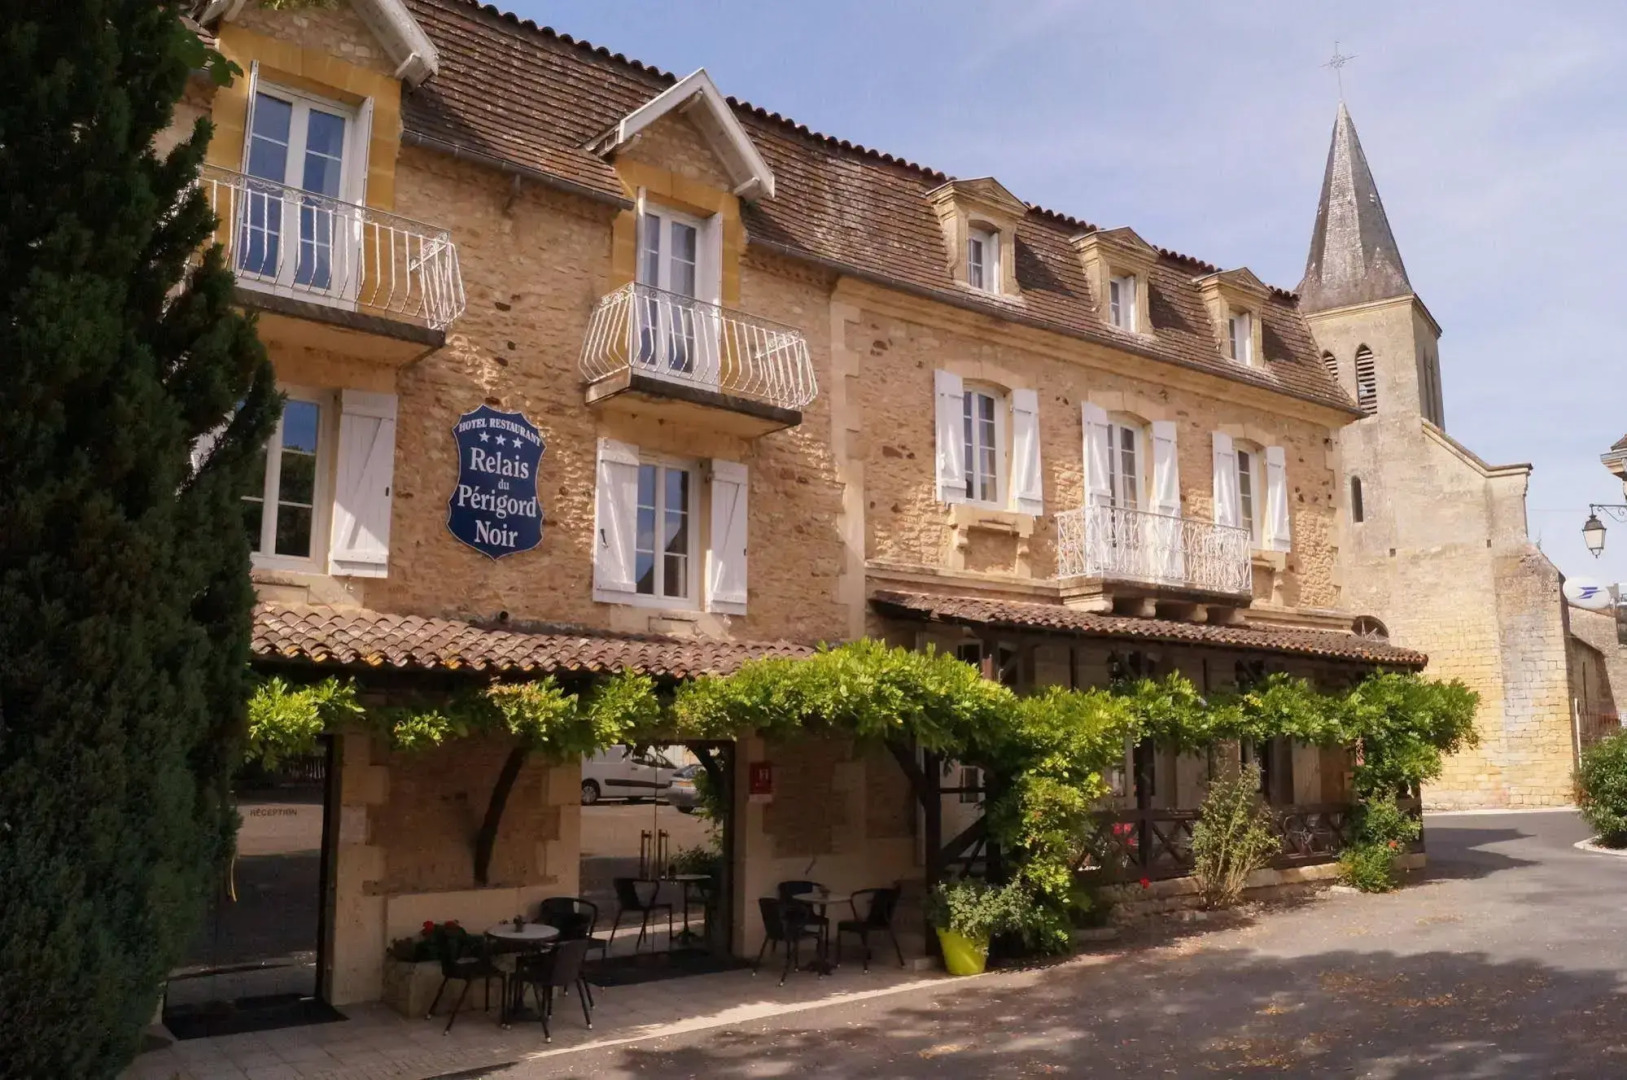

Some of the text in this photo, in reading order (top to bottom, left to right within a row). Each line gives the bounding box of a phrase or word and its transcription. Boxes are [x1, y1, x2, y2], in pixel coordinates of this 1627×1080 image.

[458, 418, 541, 447] HOTEL RESTAURANT
[469, 447, 530, 479] Relais
[498, 478, 510, 490] du
[457, 484, 537, 519] Périgord
[474, 519, 519, 548] Noir
